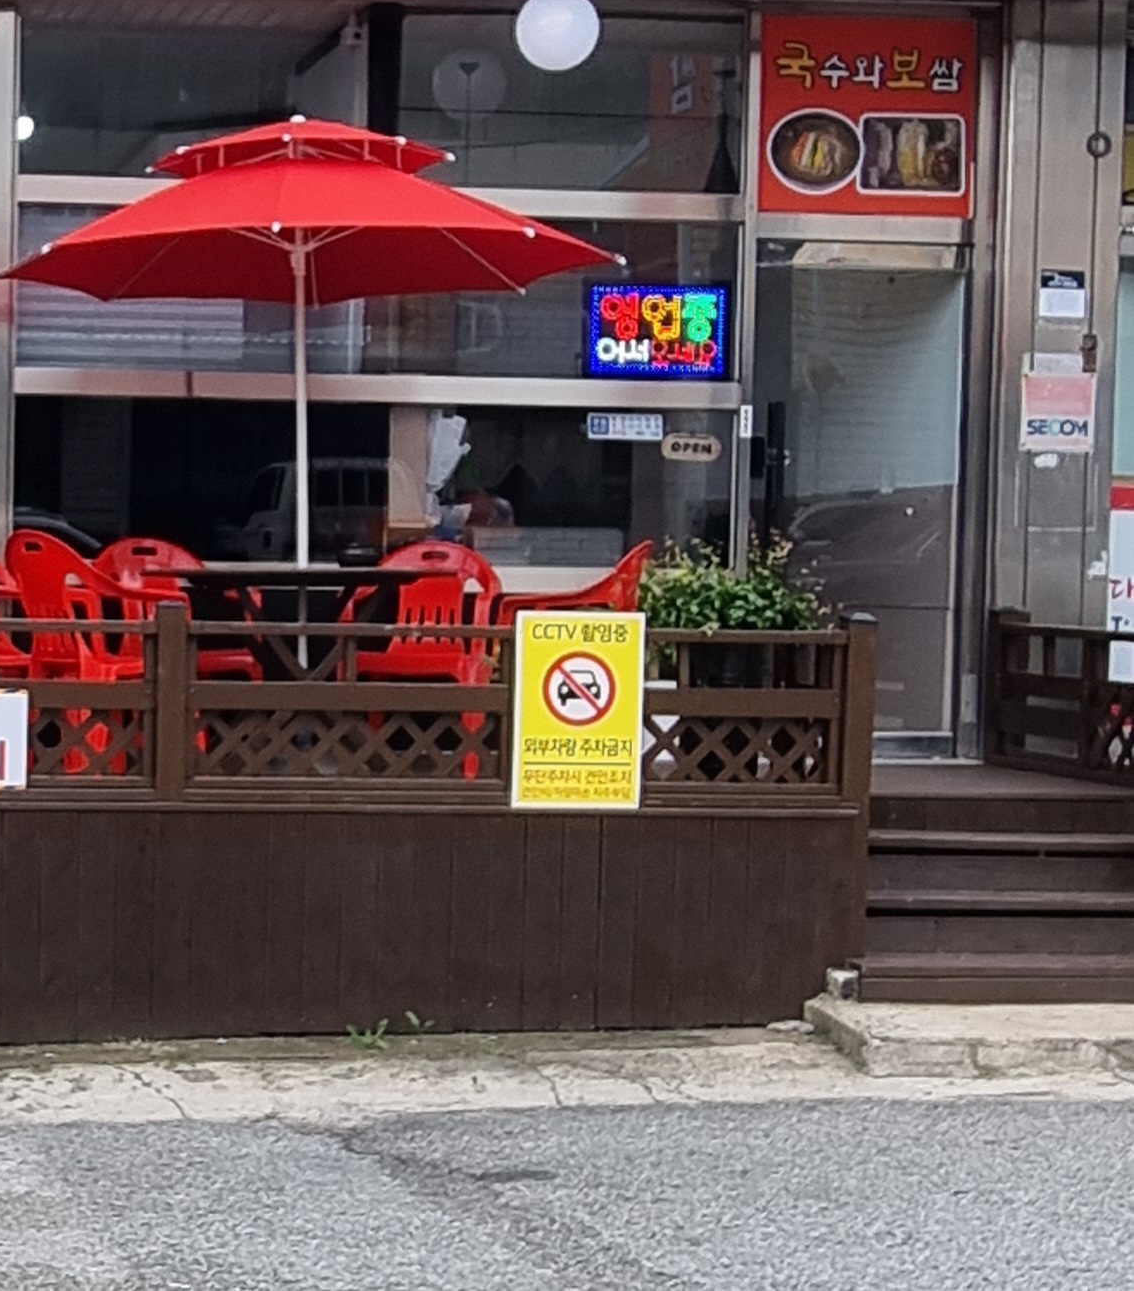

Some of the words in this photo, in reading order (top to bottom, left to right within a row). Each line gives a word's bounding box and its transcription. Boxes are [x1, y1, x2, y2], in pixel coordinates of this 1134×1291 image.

[775, 40, 963, 93] 국수와보쌈
[600, 292, 718, 342] 영업중
[1026, 418, 1089, 438] SECOM
[670, 441, 713, 455] OPEN
[532, 623, 577, 640] CCTV
[581, 623, 629, 643] 촬영중
[523, 737, 577, 757] 외부차량
[579, 738, 633, 758] 주차금지
